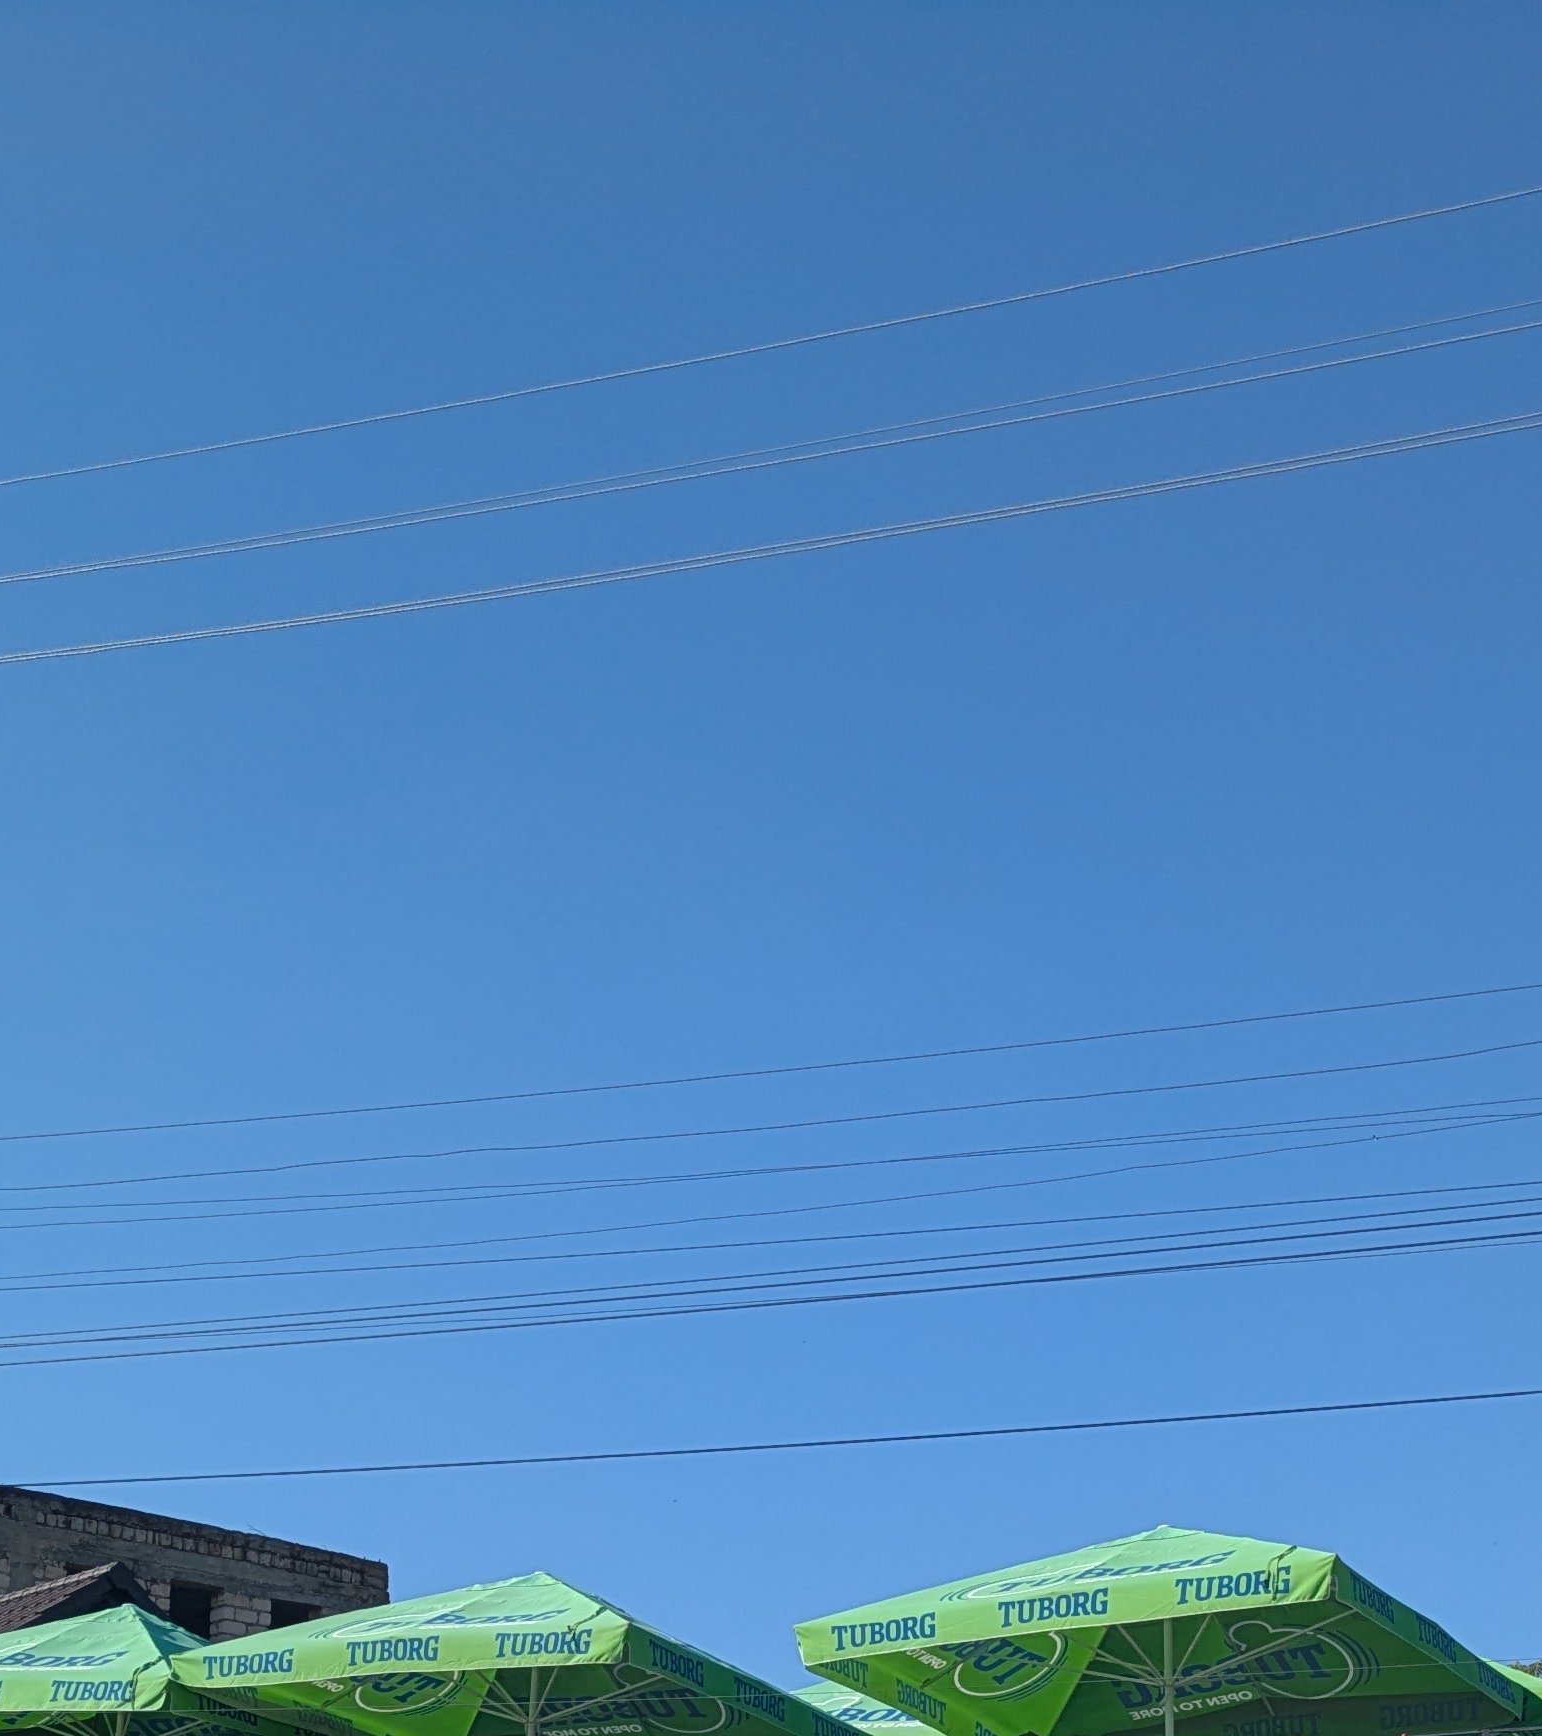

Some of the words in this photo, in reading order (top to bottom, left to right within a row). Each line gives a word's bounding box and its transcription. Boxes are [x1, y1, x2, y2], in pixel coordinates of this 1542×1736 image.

[998, 1588, 1109, 1628] TUBORG
[1349, 1570, 1395, 1624] TUBORG
[345, 1635, 439, 1666] TUBORG
[494, 1629, 592, 1658] TUBORG
[830, 1613, 936, 1651] TUBORG
[1415, 1613, 1457, 1663] TUBORG
[203, 1648, 294, 1680] TUBORG
[648, 1639, 705, 1687] TUBORG
[734, 1676, 785, 1722] TUBORG
